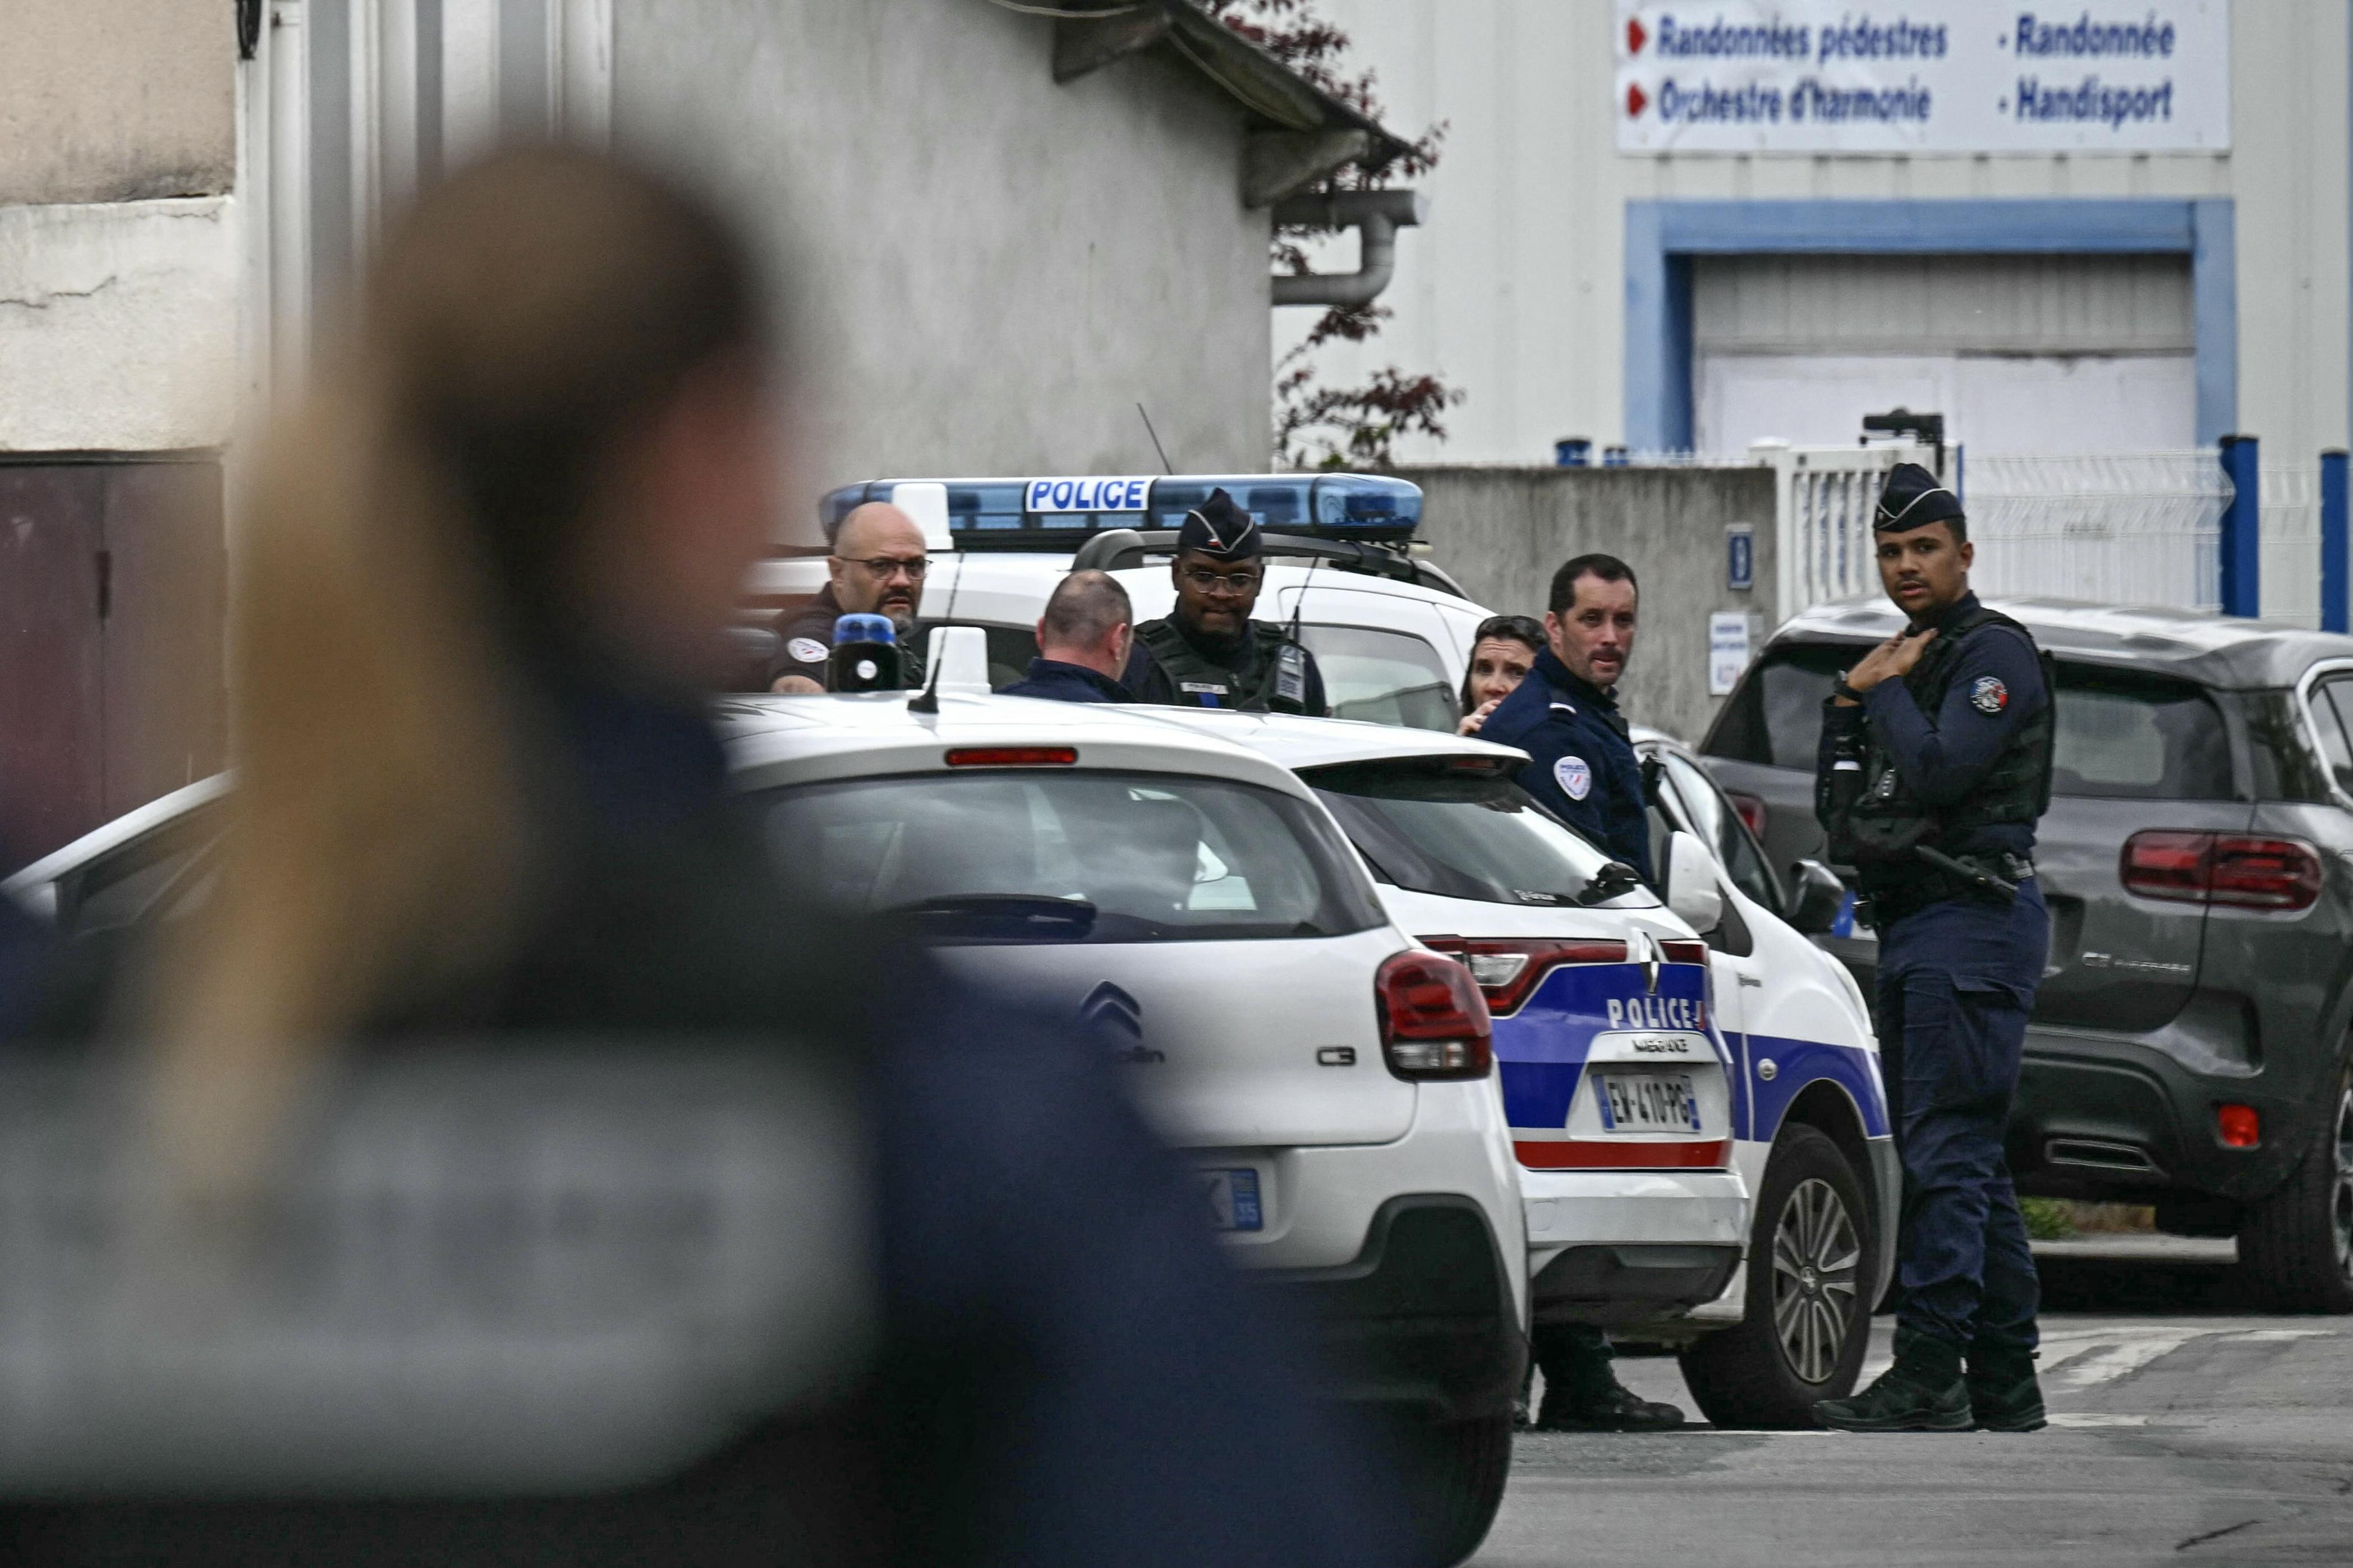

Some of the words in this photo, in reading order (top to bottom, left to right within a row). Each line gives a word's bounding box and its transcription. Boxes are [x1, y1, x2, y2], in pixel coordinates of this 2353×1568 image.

[1657, 12, 1810, 58] Randonnées
[1818, 11, 1947, 65] pédestres
[2015, 9, 2174, 58] Randonnée
[1659, 76, 1781, 122] Orchestre
[1791, 76, 1930, 122] d'harmonie
[2016, 74, 2172, 131] Handisport
[1032, 481, 1145, 509] POLICE
[1607, 998, 1694, 1029] POLICE
[1317, 1046, 1357, 1066] C3
